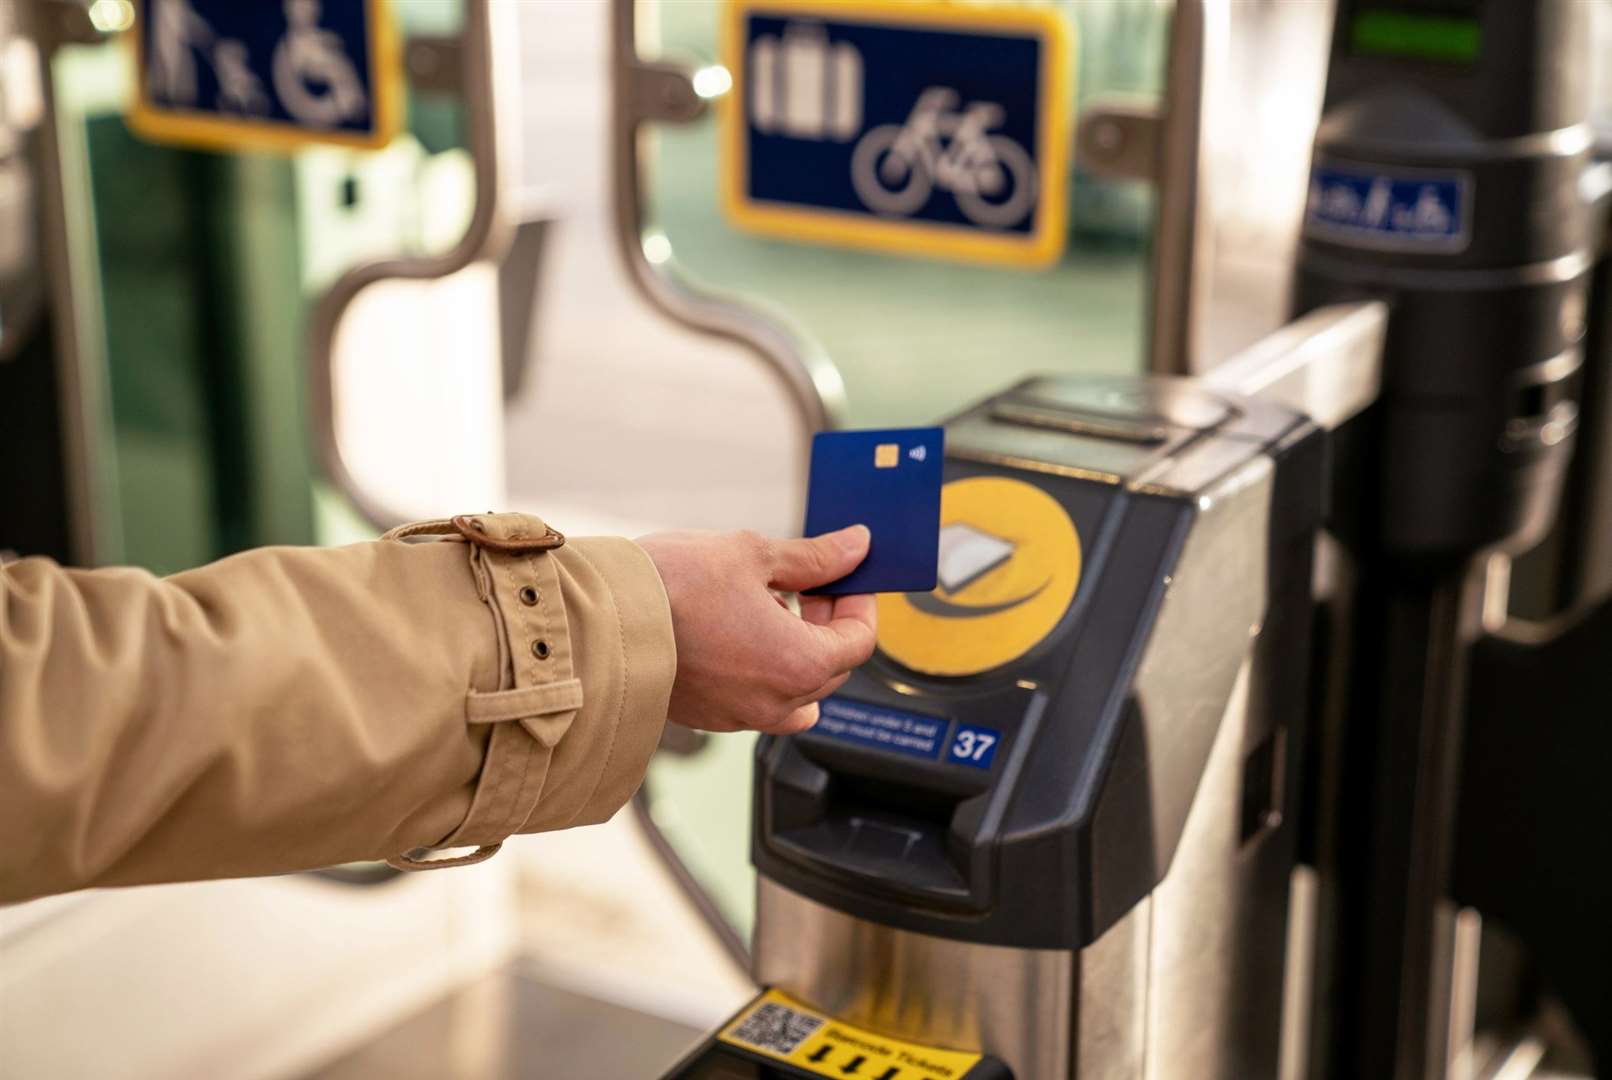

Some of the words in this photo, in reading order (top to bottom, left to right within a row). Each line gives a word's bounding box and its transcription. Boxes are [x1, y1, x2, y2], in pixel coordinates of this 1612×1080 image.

[847, 724, 875, 738] must
[876, 731, 891, 743] be
[892, 736, 935, 751] carried
[870, 714, 903, 730] under
[914, 724, 938, 737] and
[953, 730, 995, 761] 37
[826, 1029, 892, 1056] Barcode
[897, 1051, 953, 1077] Tickets
